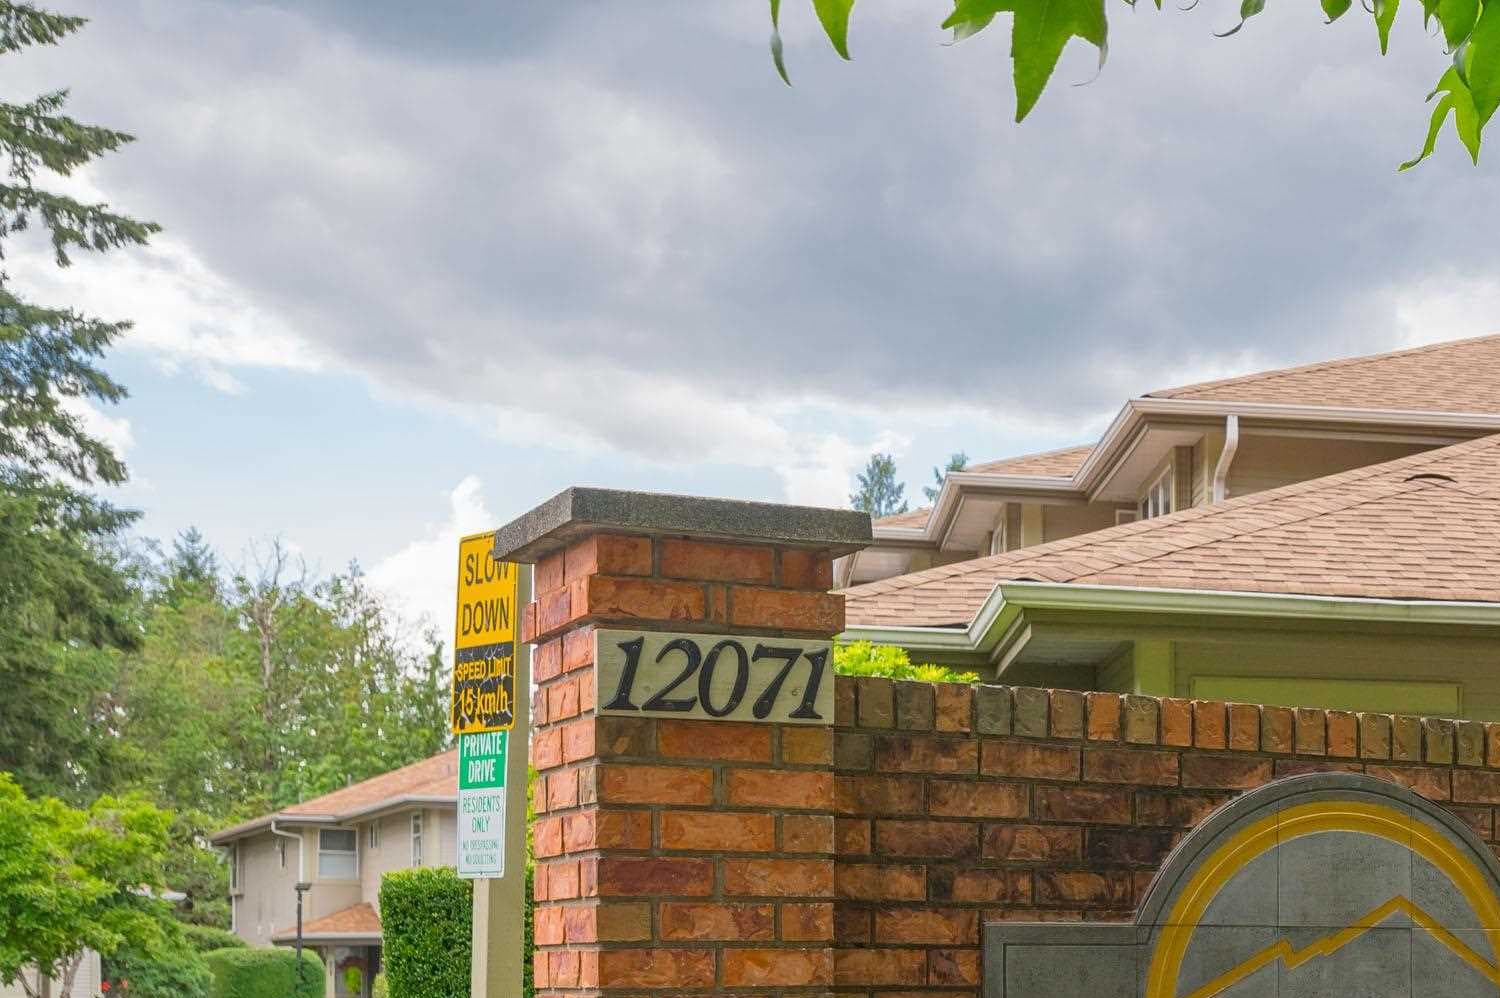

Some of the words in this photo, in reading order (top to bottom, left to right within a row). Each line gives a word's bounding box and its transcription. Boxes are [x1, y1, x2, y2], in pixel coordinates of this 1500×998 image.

[465, 549, 510, 587] SLOW
[462, 596, 509, 636] DOWN
[457, 660, 486, 681] SPEED
[602, 636, 830, 719] 12071
[463, 731, 503, 757] PRIVATE
[468, 758, 497, 783] DRIVE
[462, 795, 502, 814] RESIDENTS
[472, 815, 490, 832] ONLY
